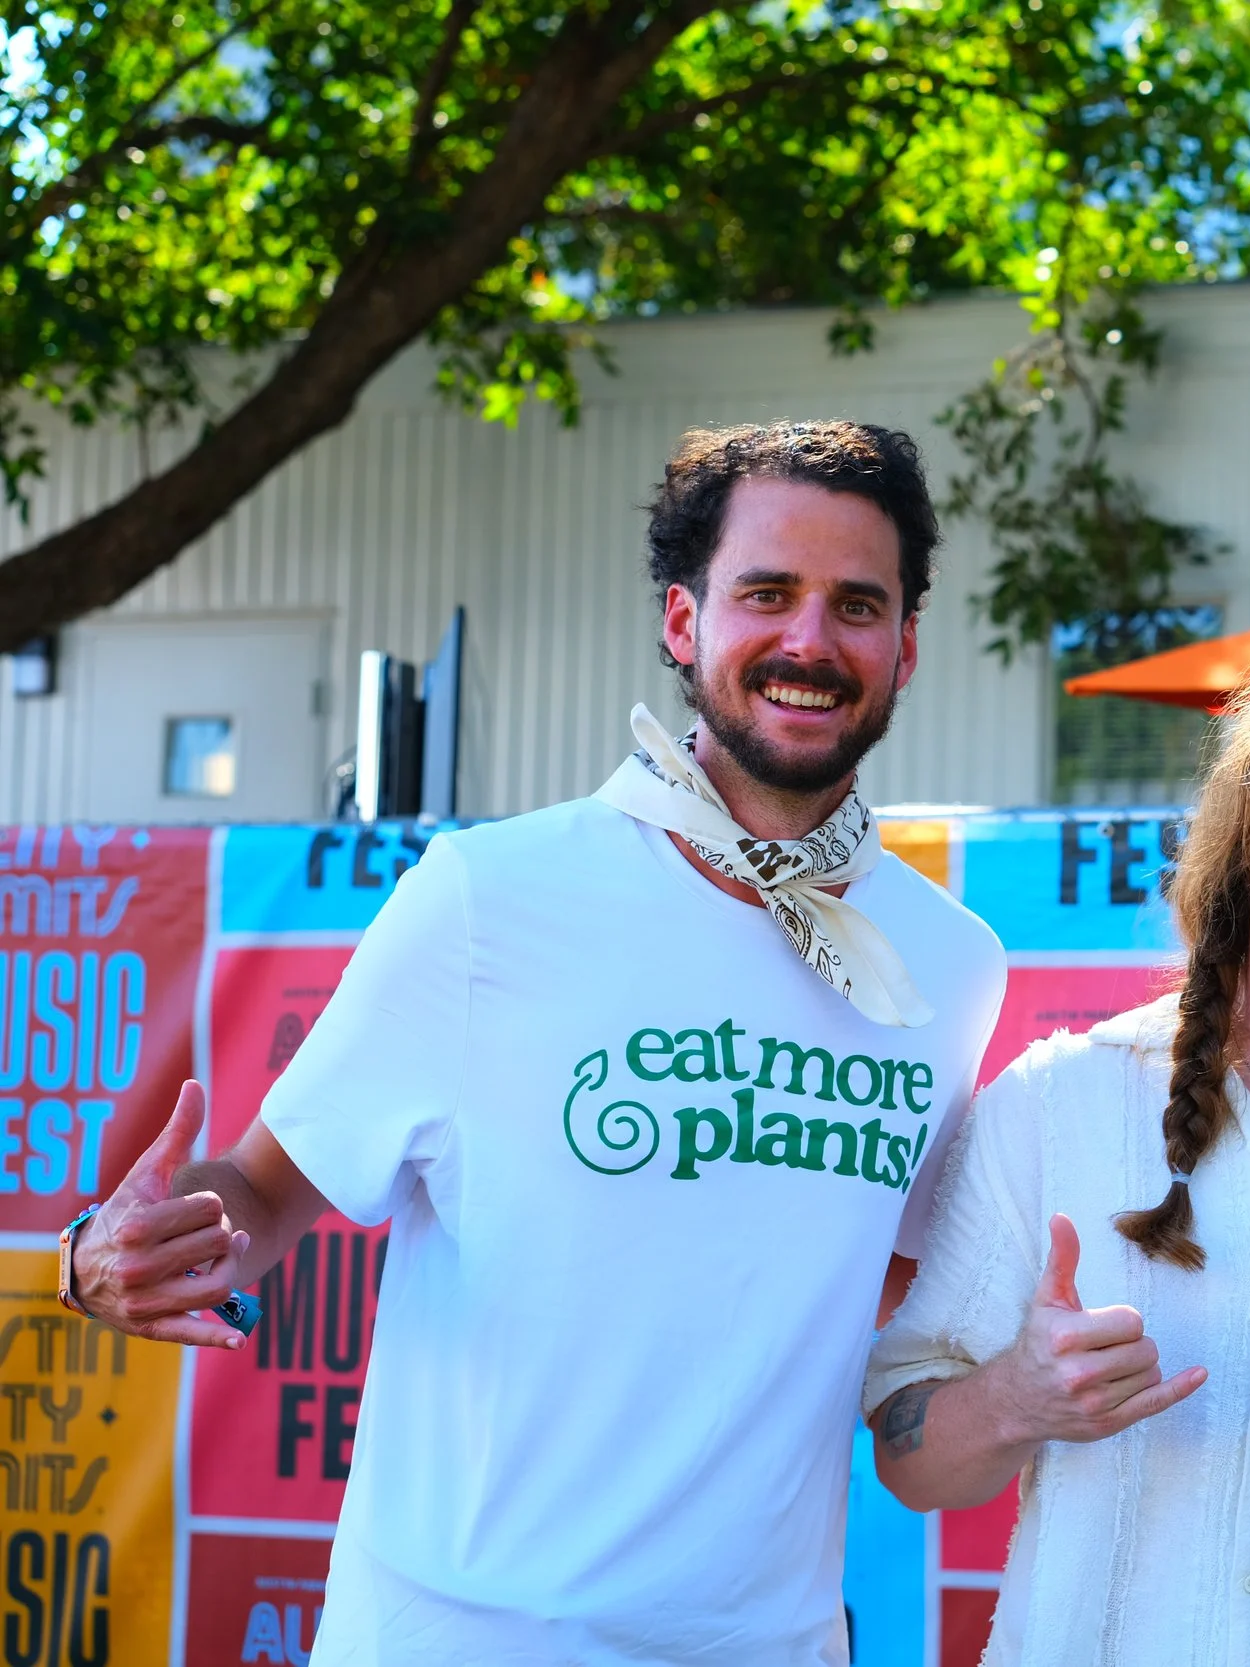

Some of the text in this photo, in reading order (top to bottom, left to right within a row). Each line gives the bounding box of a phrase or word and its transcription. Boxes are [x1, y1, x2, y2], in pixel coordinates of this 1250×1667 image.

[0, 826, 117, 870] ITY
[626, 1018, 934, 1115] eat more
[670, 1087, 928, 1194] plants!
